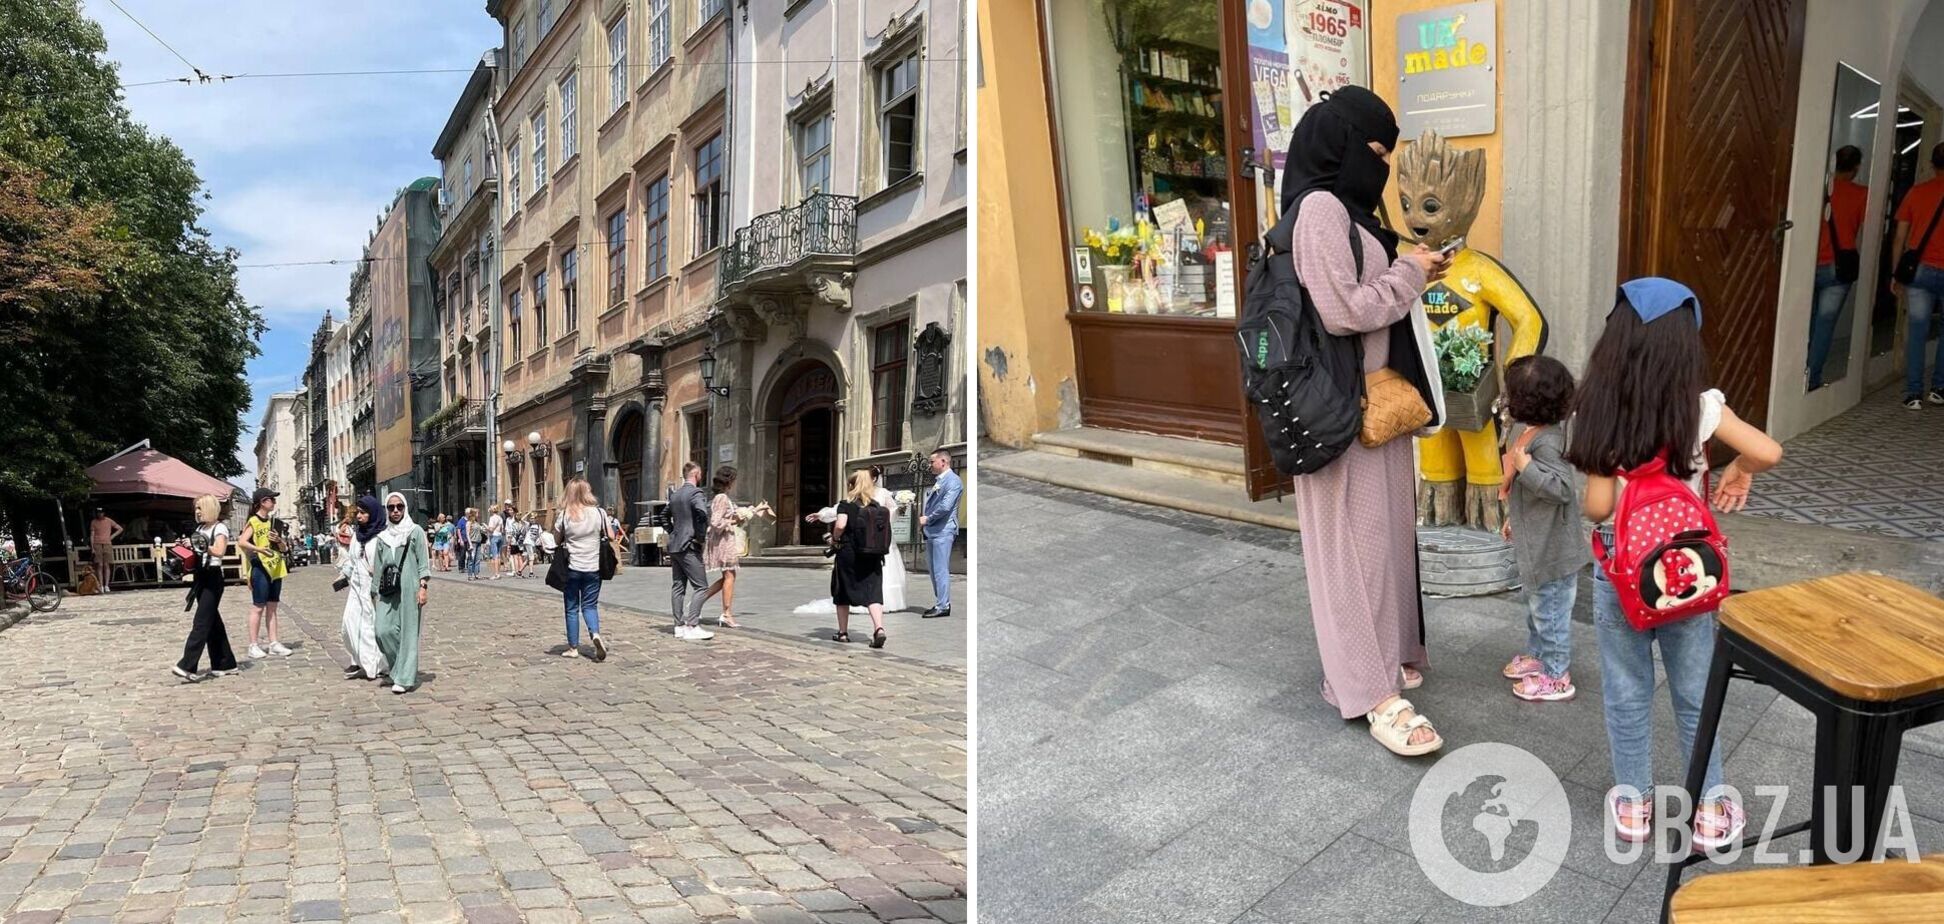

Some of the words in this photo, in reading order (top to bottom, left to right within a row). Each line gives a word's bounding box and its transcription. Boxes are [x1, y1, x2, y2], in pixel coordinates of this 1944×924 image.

[1308, 12, 1347, 38] 1965
[1418, 15, 1459, 50] UA
[1403, 37, 1488, 75] made
[1424, 302, 1459, 314] made
